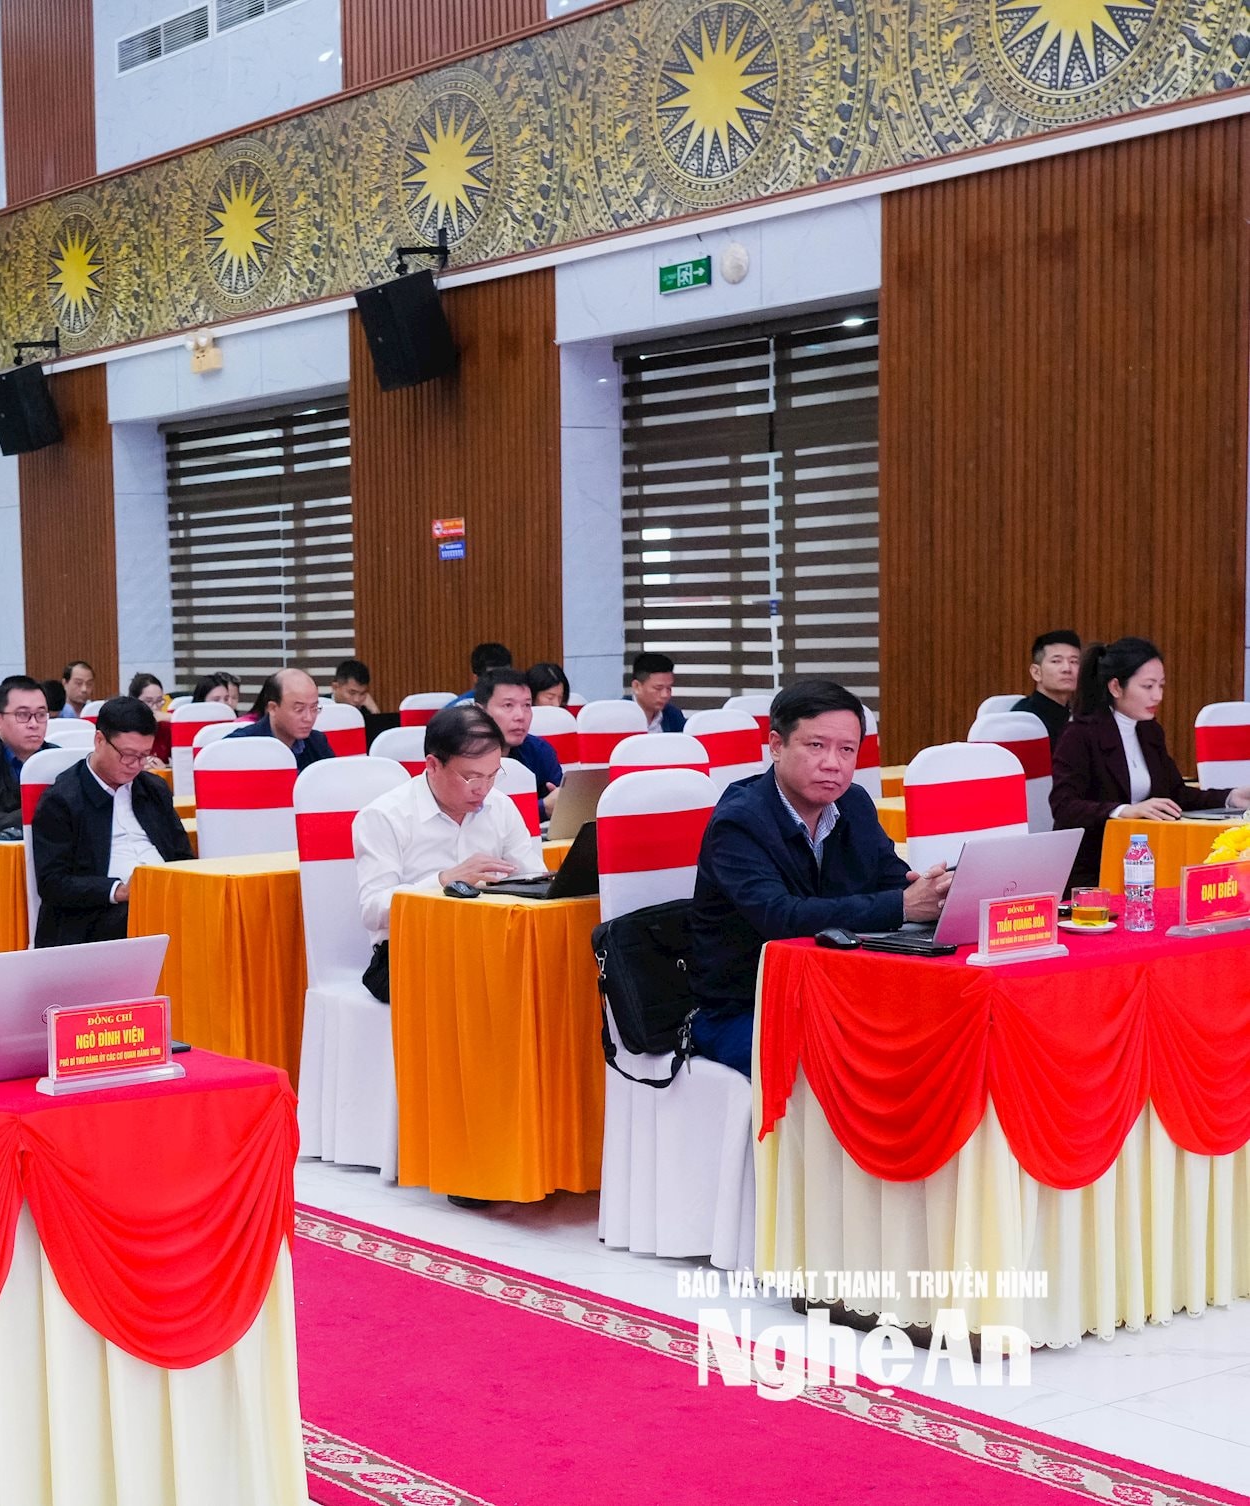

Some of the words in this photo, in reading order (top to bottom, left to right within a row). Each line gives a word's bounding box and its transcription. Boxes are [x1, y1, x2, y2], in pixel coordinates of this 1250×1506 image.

[1201, 884, 1216, 904] ĐẠI
[1217, 874, 1238, 899] BIỂU
[87, 1013, 114, 1026] ĐỒNG
[116, 1011, 133, 1022] CHÍ
[75, 1031, 96, 1050] NGÔ
[98, 1028, 121, 1047] ĐÌNH
[122, 1025, 145, 1047] VIỆN
[106, 1051, 117, 1062] CÁC
